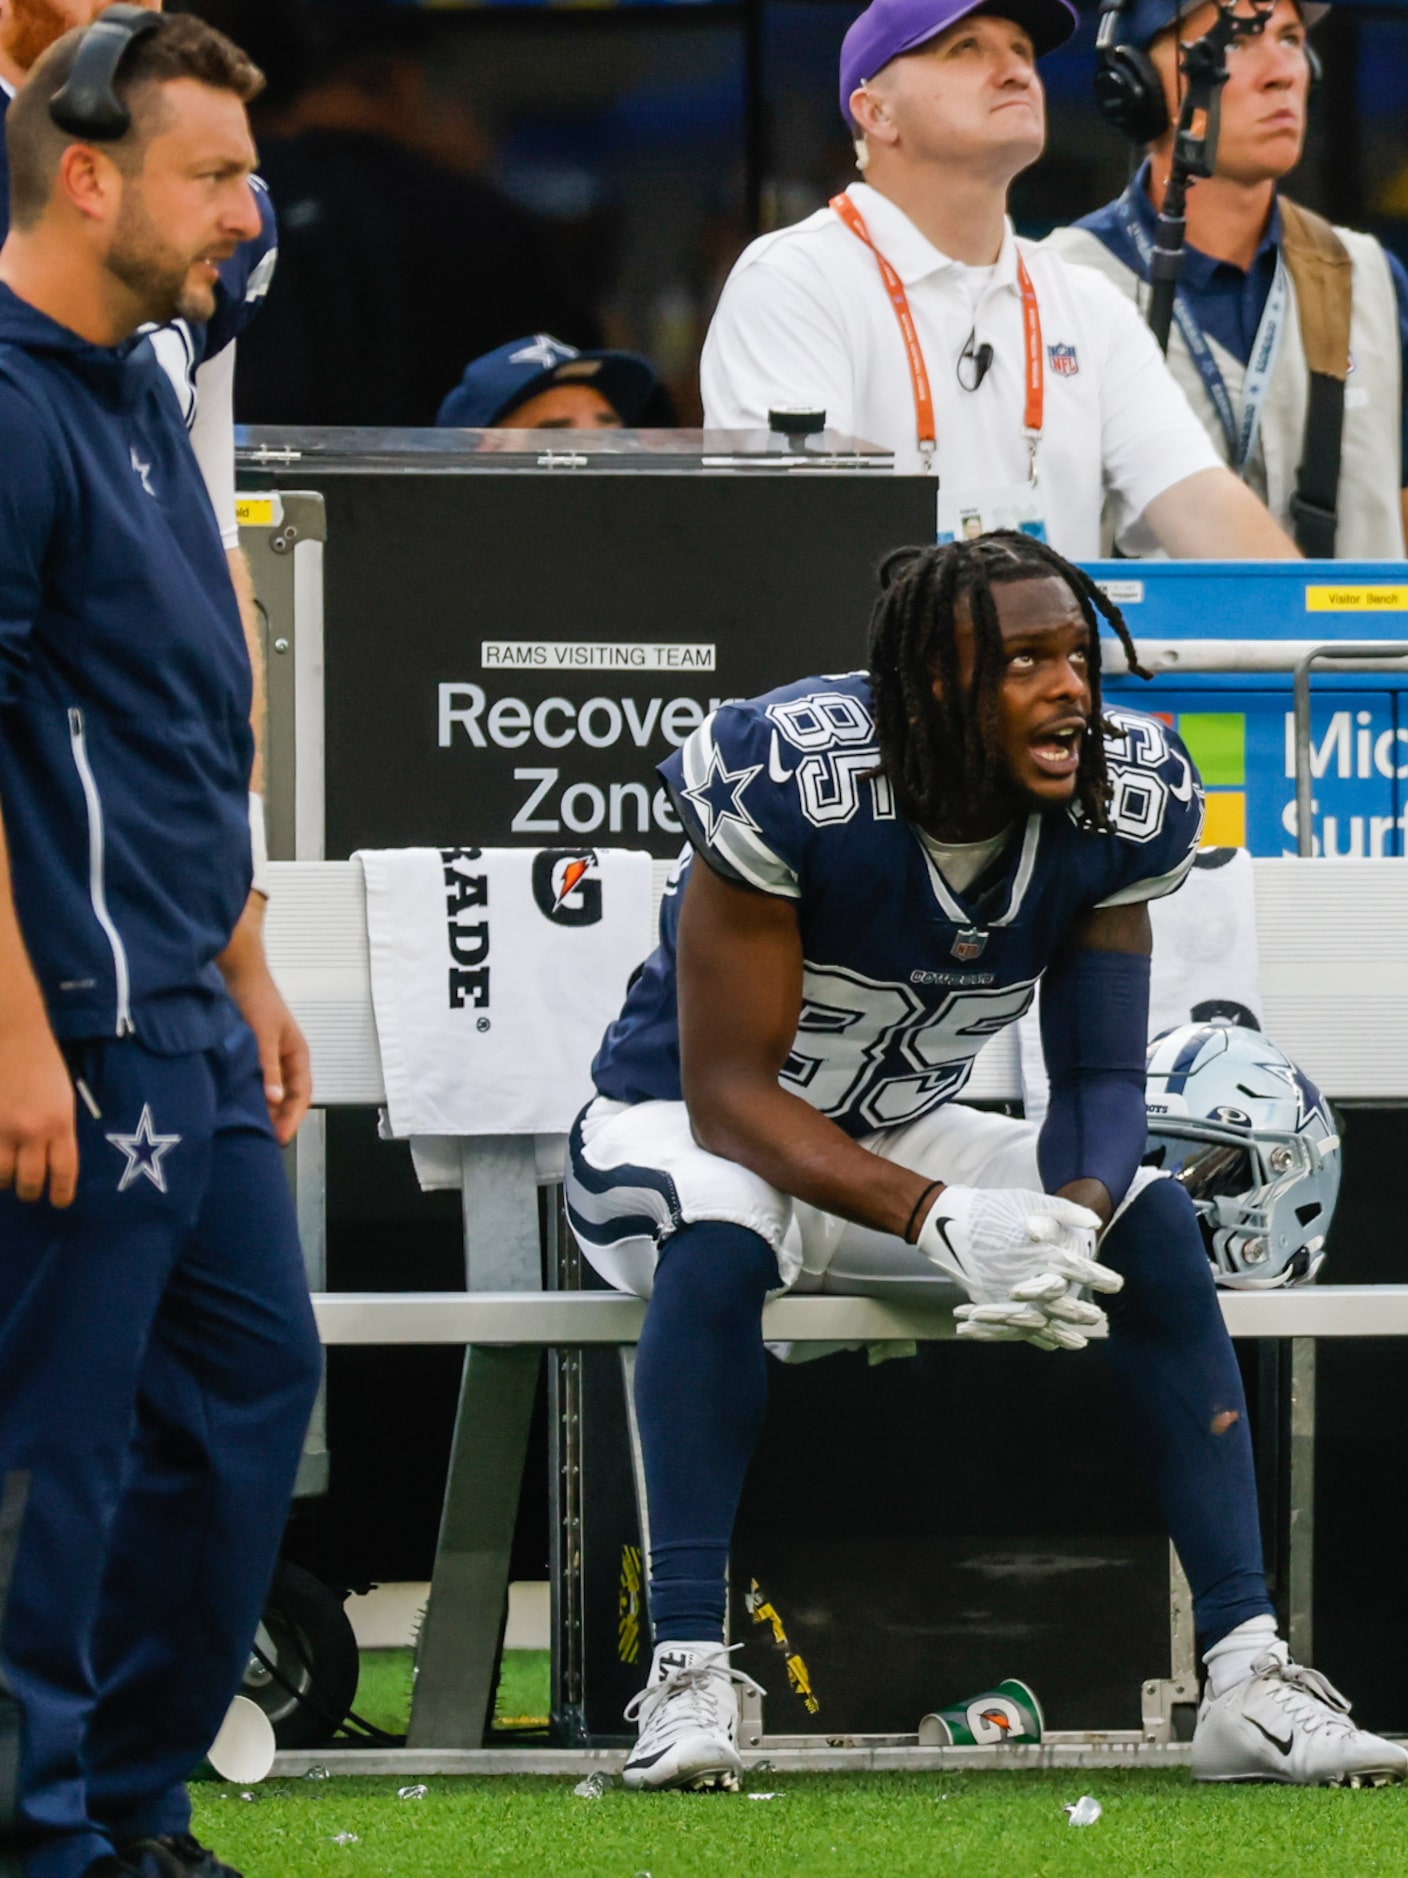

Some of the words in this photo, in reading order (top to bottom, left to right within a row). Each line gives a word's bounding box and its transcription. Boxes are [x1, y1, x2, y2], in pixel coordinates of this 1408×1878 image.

[486, 646, 547, 665] RAMS
[554, 646, 646, 666] VISITING
[656, 647, 712, 666] TEAM
[438, 682, 746, 748] Recove
[765, 692, 896, 827] 85
